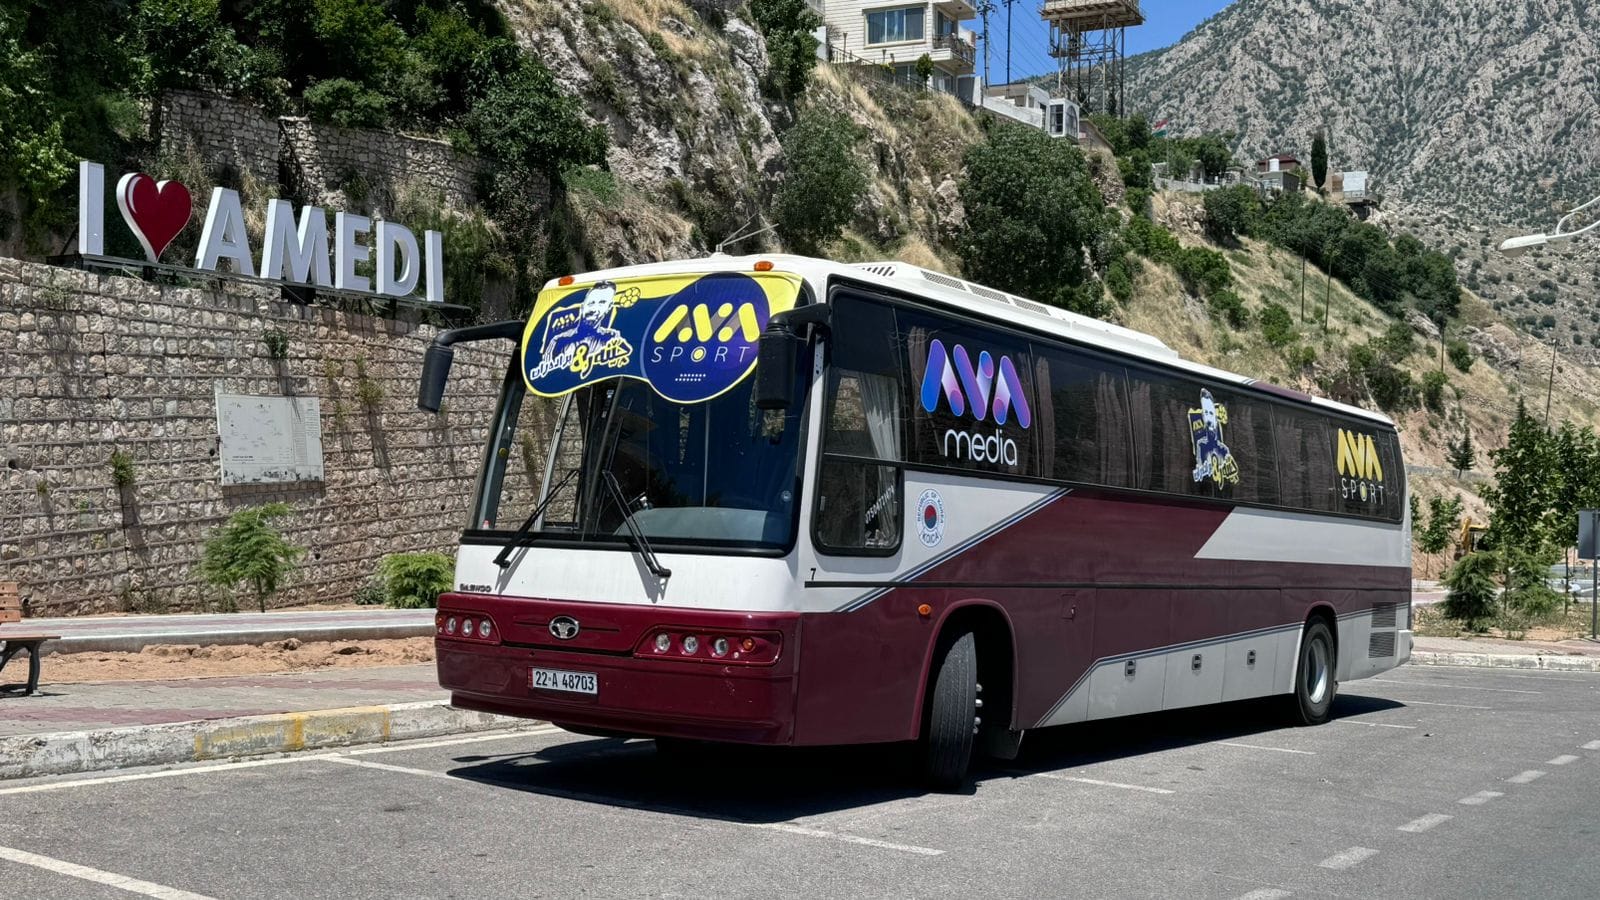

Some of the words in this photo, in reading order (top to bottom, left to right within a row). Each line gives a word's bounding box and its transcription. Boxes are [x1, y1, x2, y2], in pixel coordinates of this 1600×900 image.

[79, 161, 104, 256] I
[196, 187, 444, 303] AMEDI
[653, 302, 760, 343] AVA
[651, 346, 750, 363] SPORT
[921, 339, 1031, 429] AVA
[944, 428, 1018, 466] media
[1337, 428, 1383, 482] AVA
[1341, 477, 1384, 505] SPORT
[562, 674, 594, 691] 48703
